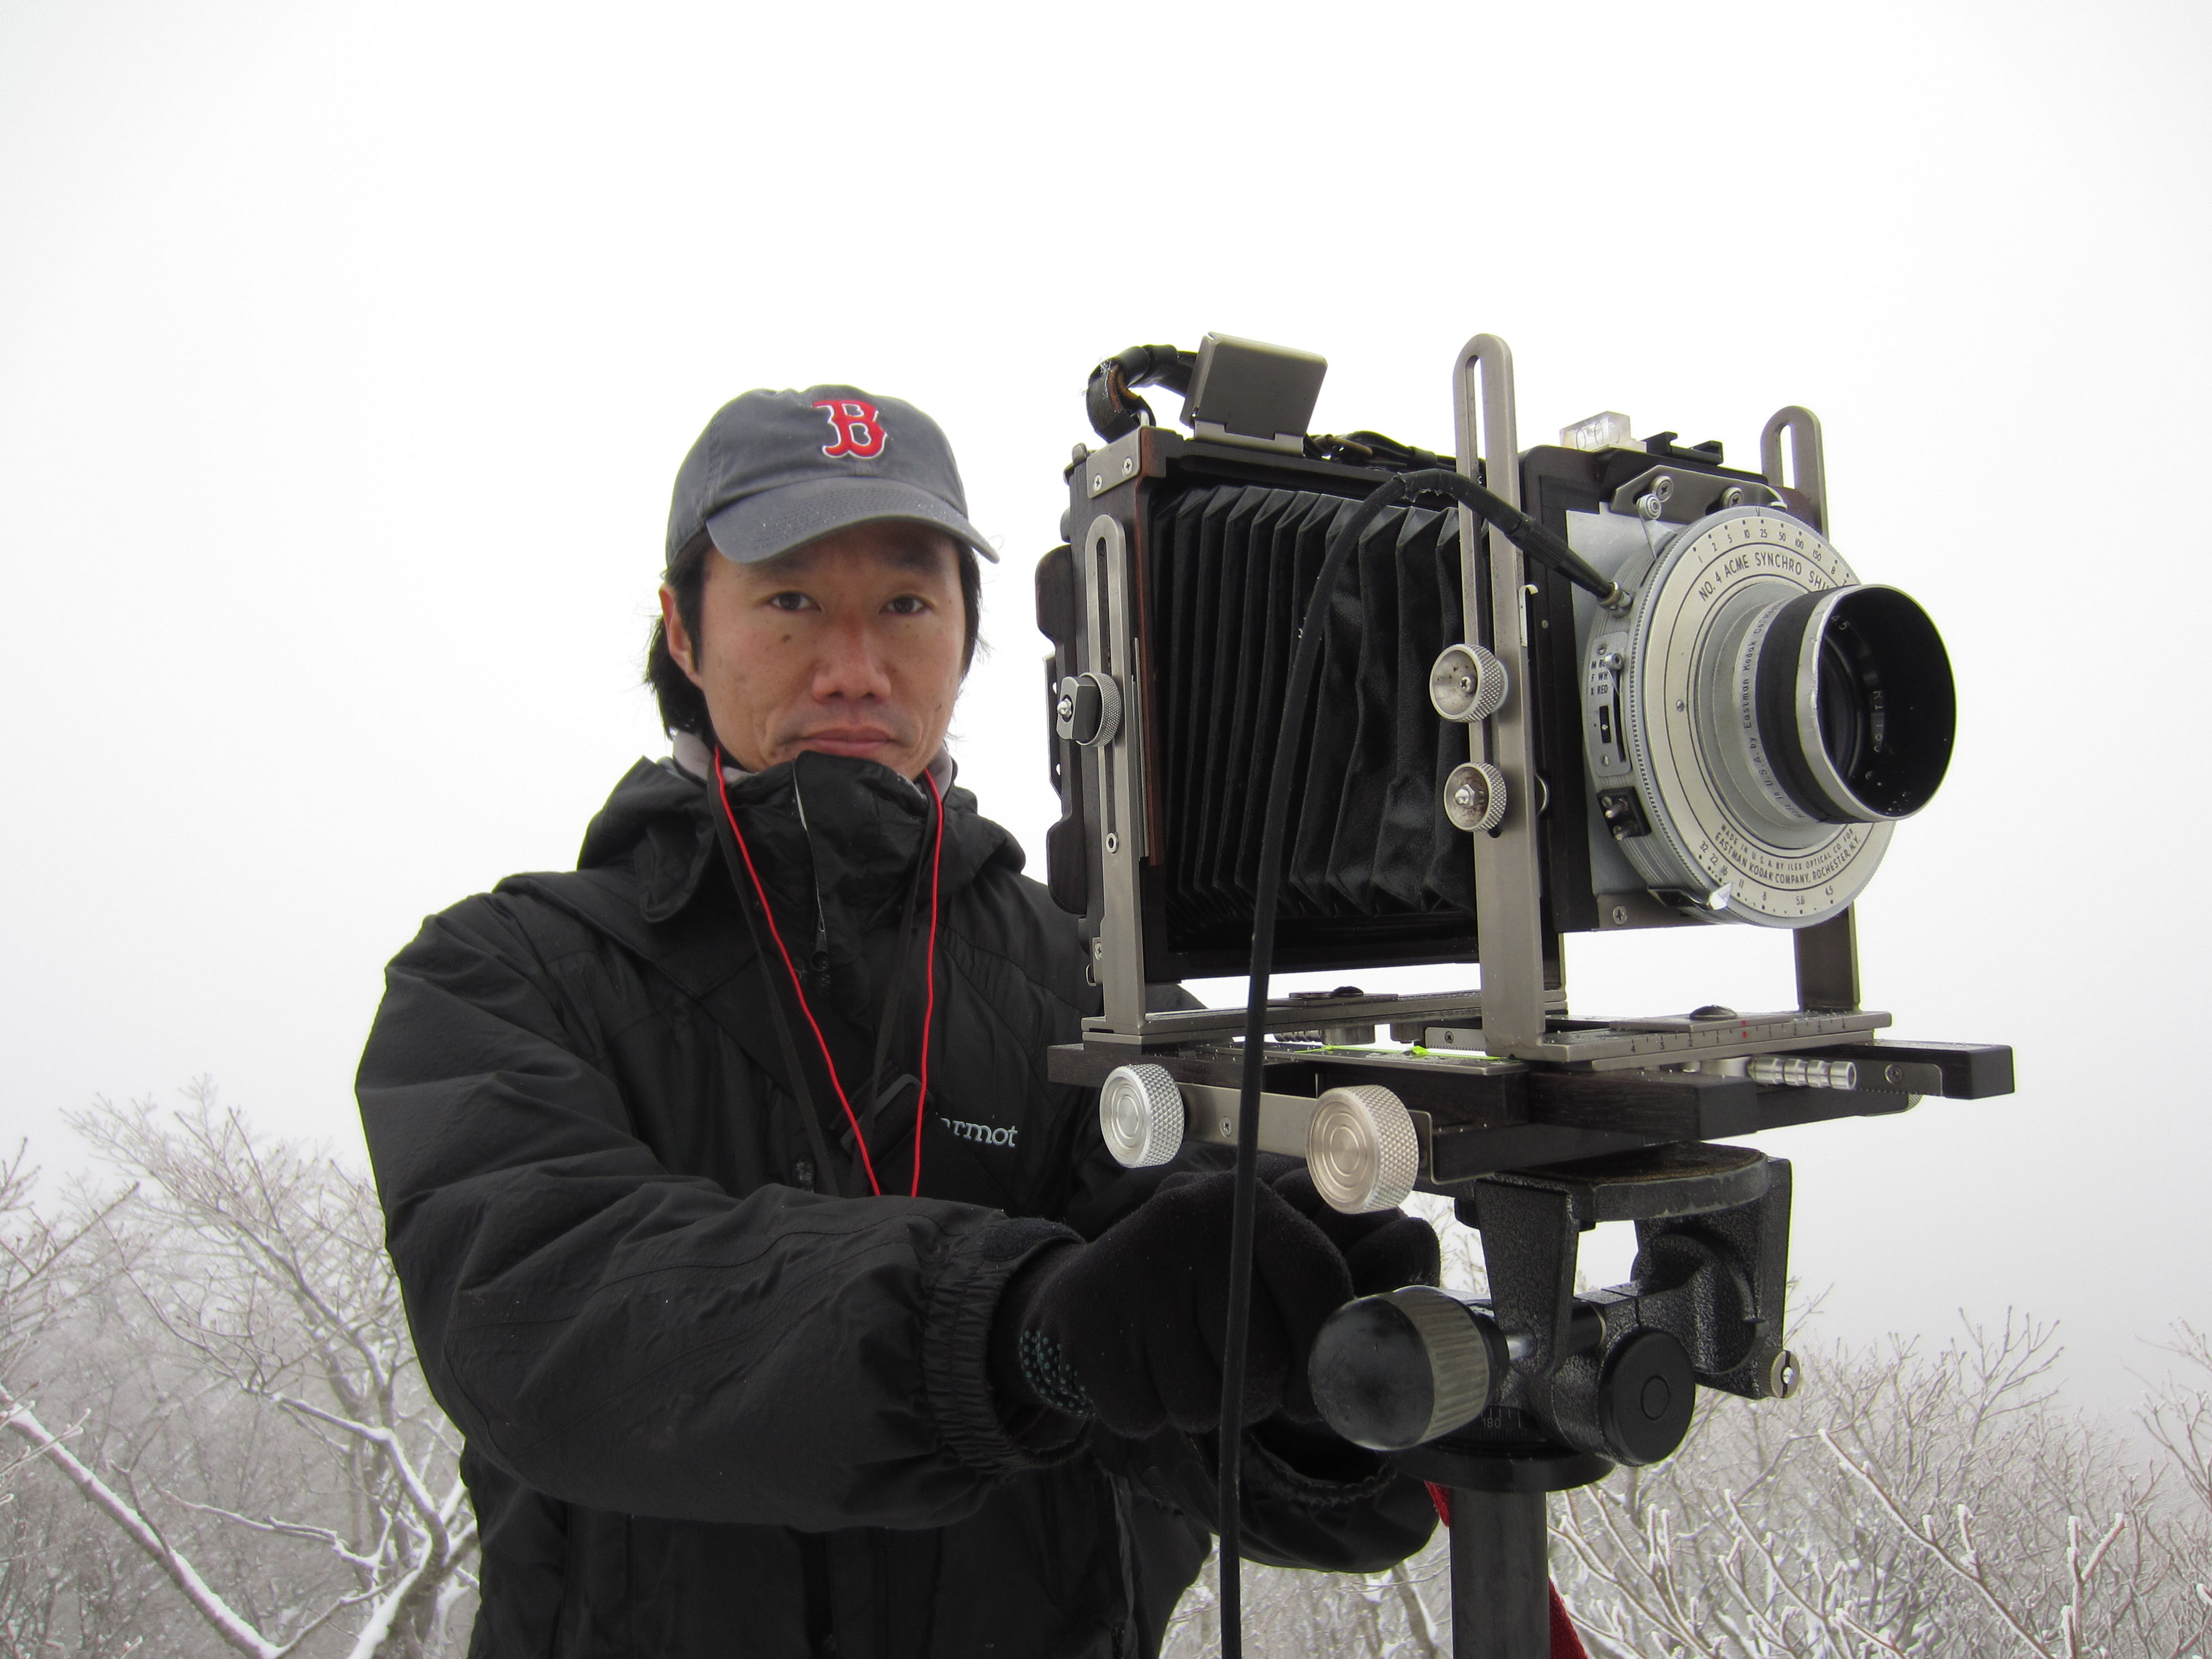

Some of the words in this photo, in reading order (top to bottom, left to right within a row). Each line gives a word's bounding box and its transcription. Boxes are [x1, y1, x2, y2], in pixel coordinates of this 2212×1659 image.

[812, 400, 888, 459] B
[1712, 542, 1718, 552] 2
[1727, 534, 1733, 543] 5
[1743, 529, 1750, 539] 10
[1760, 529, 1767, 538] 25
[1778, 531, 1786, 541] 50
[1795, 538, 1804, 549] 100
[1812, 549, 1822, 561] 150
[1698, 581, 1715, 602] NO.
[1715, 571, 1722, 583] 4
[1724, 555, 1749, 578] ACME
[1755, 552, 1802, 575] SYNCHRO
[1742, 640, 1757, 671] Kodak
[1597, 684, 1608, 694] RED
[1742, 679, 1752, 729] Eastman
[1699, 841, 1709, 853] 32
[1709, 853, 1719, 865] 22
[1721, 865, 1728, 876] 16
[1739, 879, 1745, 889] 11
[1762, 891, 1767, 901] 8
[1715, 832, 1747, 867] EASTMAN
[1749, 862, 1773, 880] KODAK
[1721, 824, 1739, 845] MADE
[1787, 863, 1802, 871] ILEX
[1806, 852, 1832, 869] OPTICAL
[1482, 1417, 1501, 1429] 180
